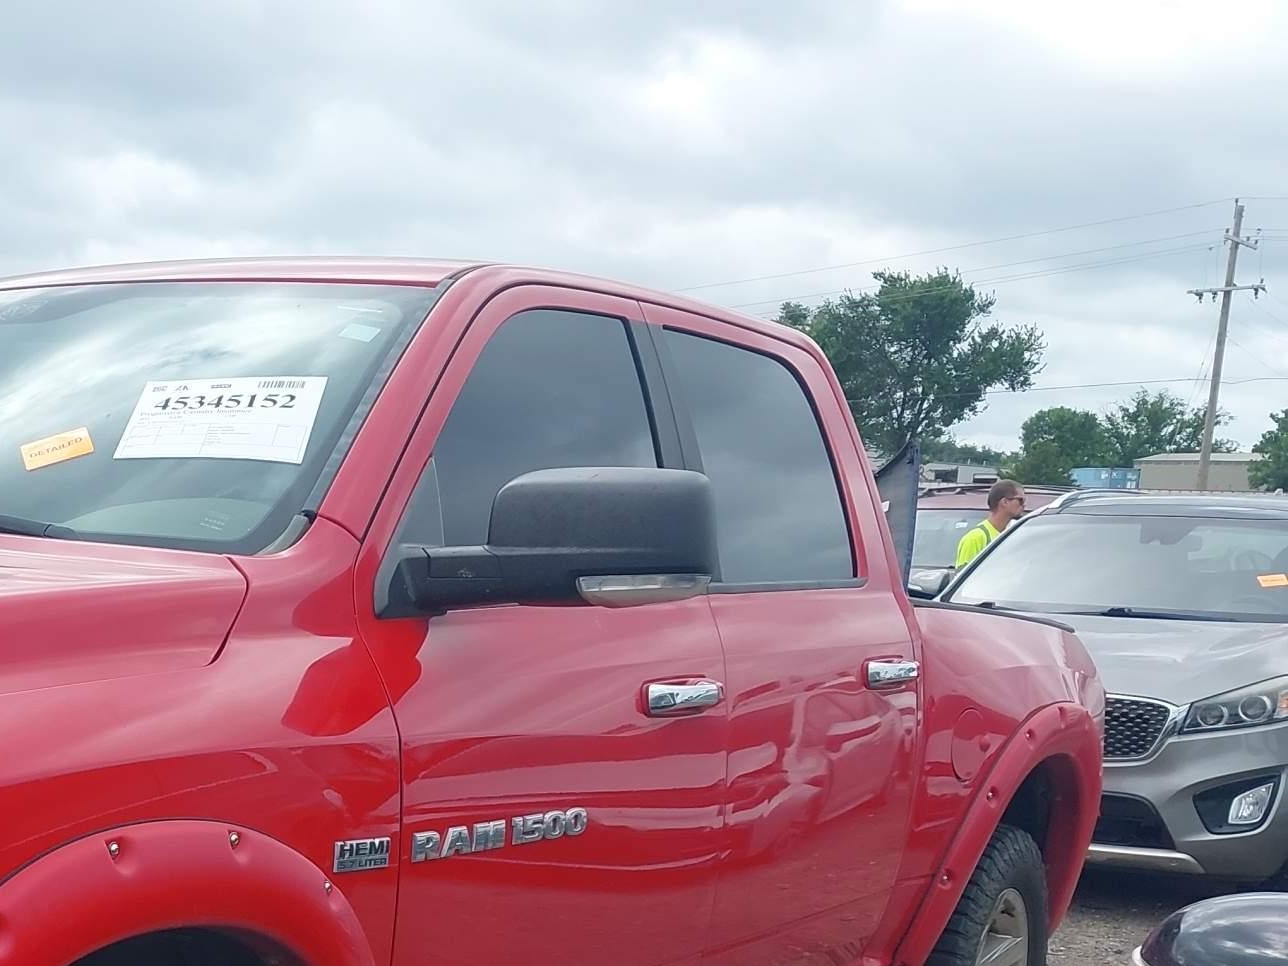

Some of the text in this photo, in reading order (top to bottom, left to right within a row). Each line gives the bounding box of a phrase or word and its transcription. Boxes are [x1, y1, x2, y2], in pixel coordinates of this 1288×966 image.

[154, 393, 297, 411] 45345152
[29, 437, 83, 458] DETAILED
[411, 807, 588, 863] RAM 1500
[338, 838, 390, 859] HEMI
[357, 858, 388, 868] LITER
